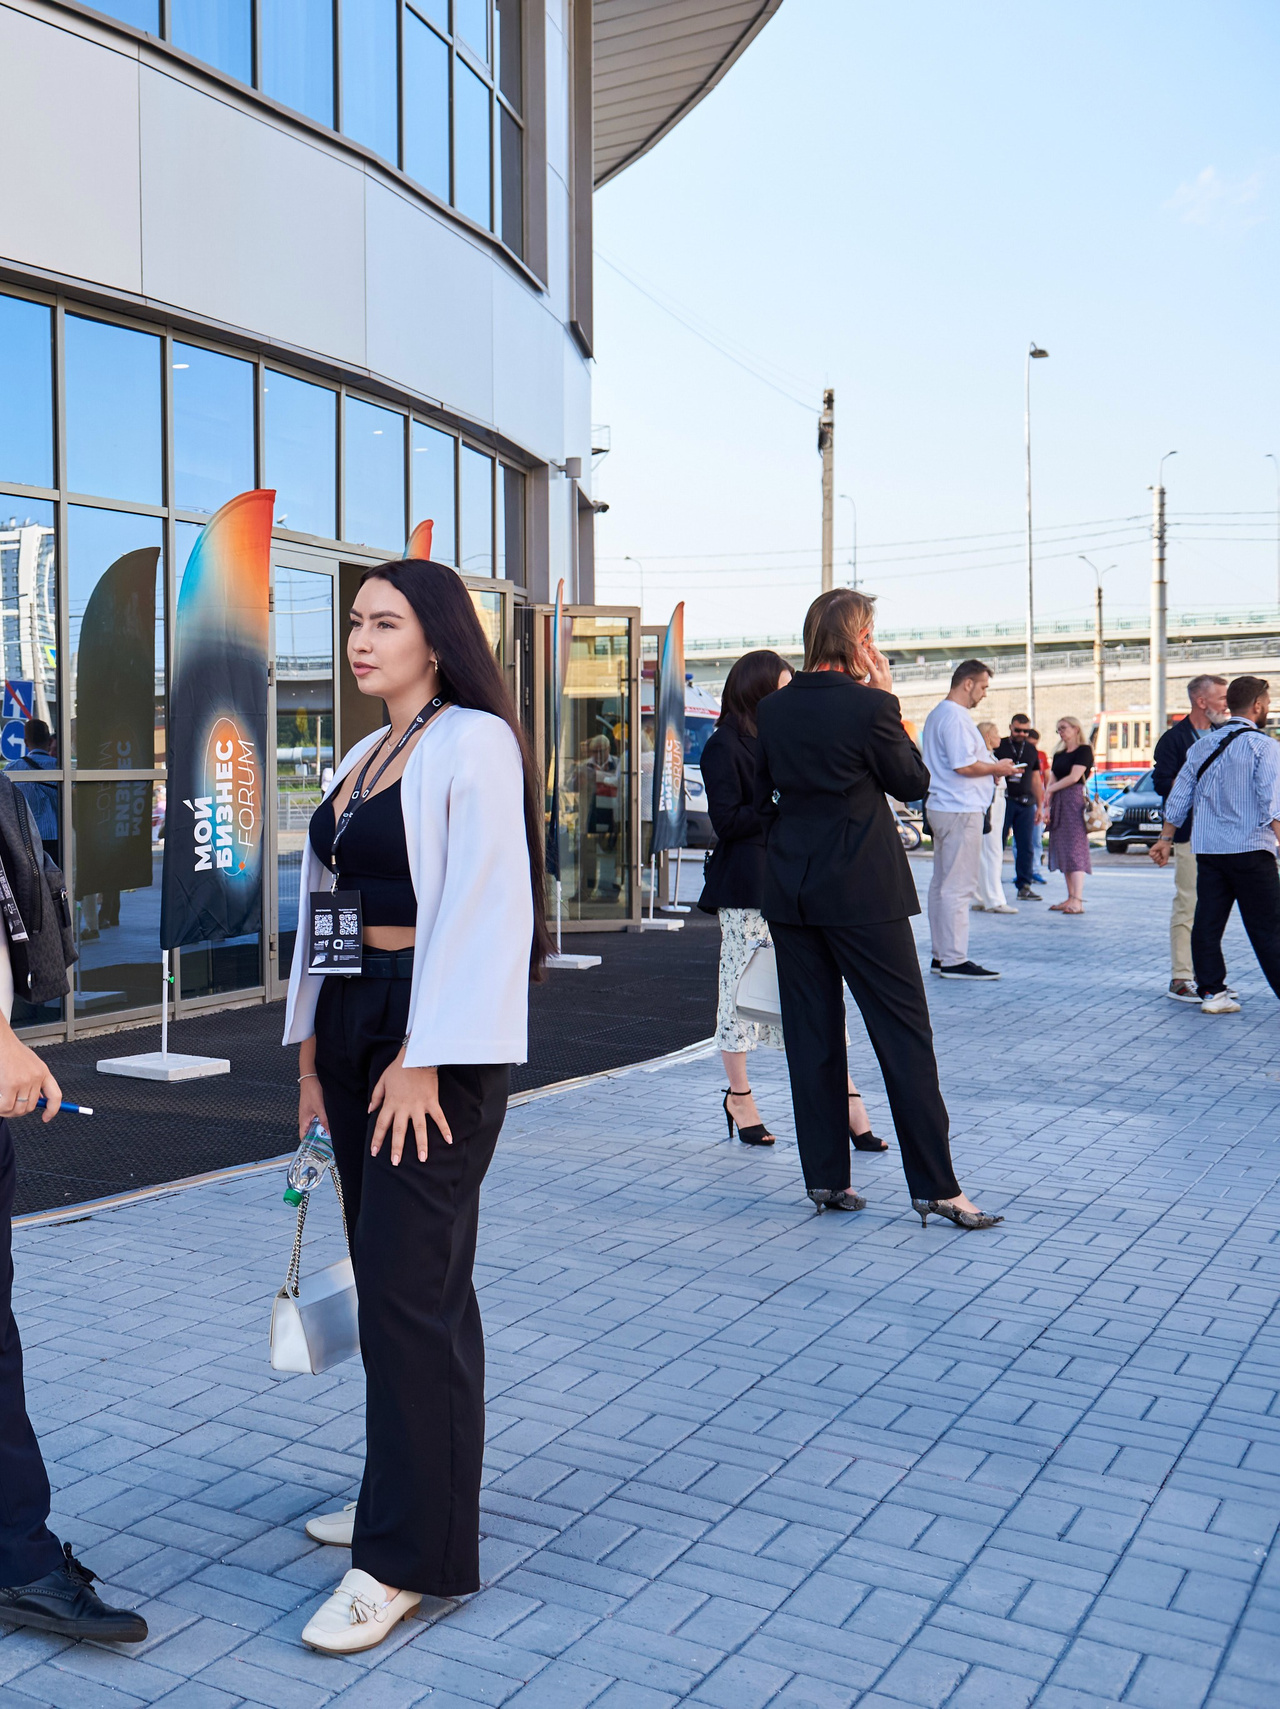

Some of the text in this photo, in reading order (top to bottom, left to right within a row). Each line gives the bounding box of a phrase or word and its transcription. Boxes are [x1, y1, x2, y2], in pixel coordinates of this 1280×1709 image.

[215, 739, 234, 868] БИЗНЕС
[238, 739, 255, 847] FORUM
[665, 739, 673, 810] БИЗНЕС
[673, 739, 681, 800] FORUM
[182, 796, 213, 872] МОЙ
